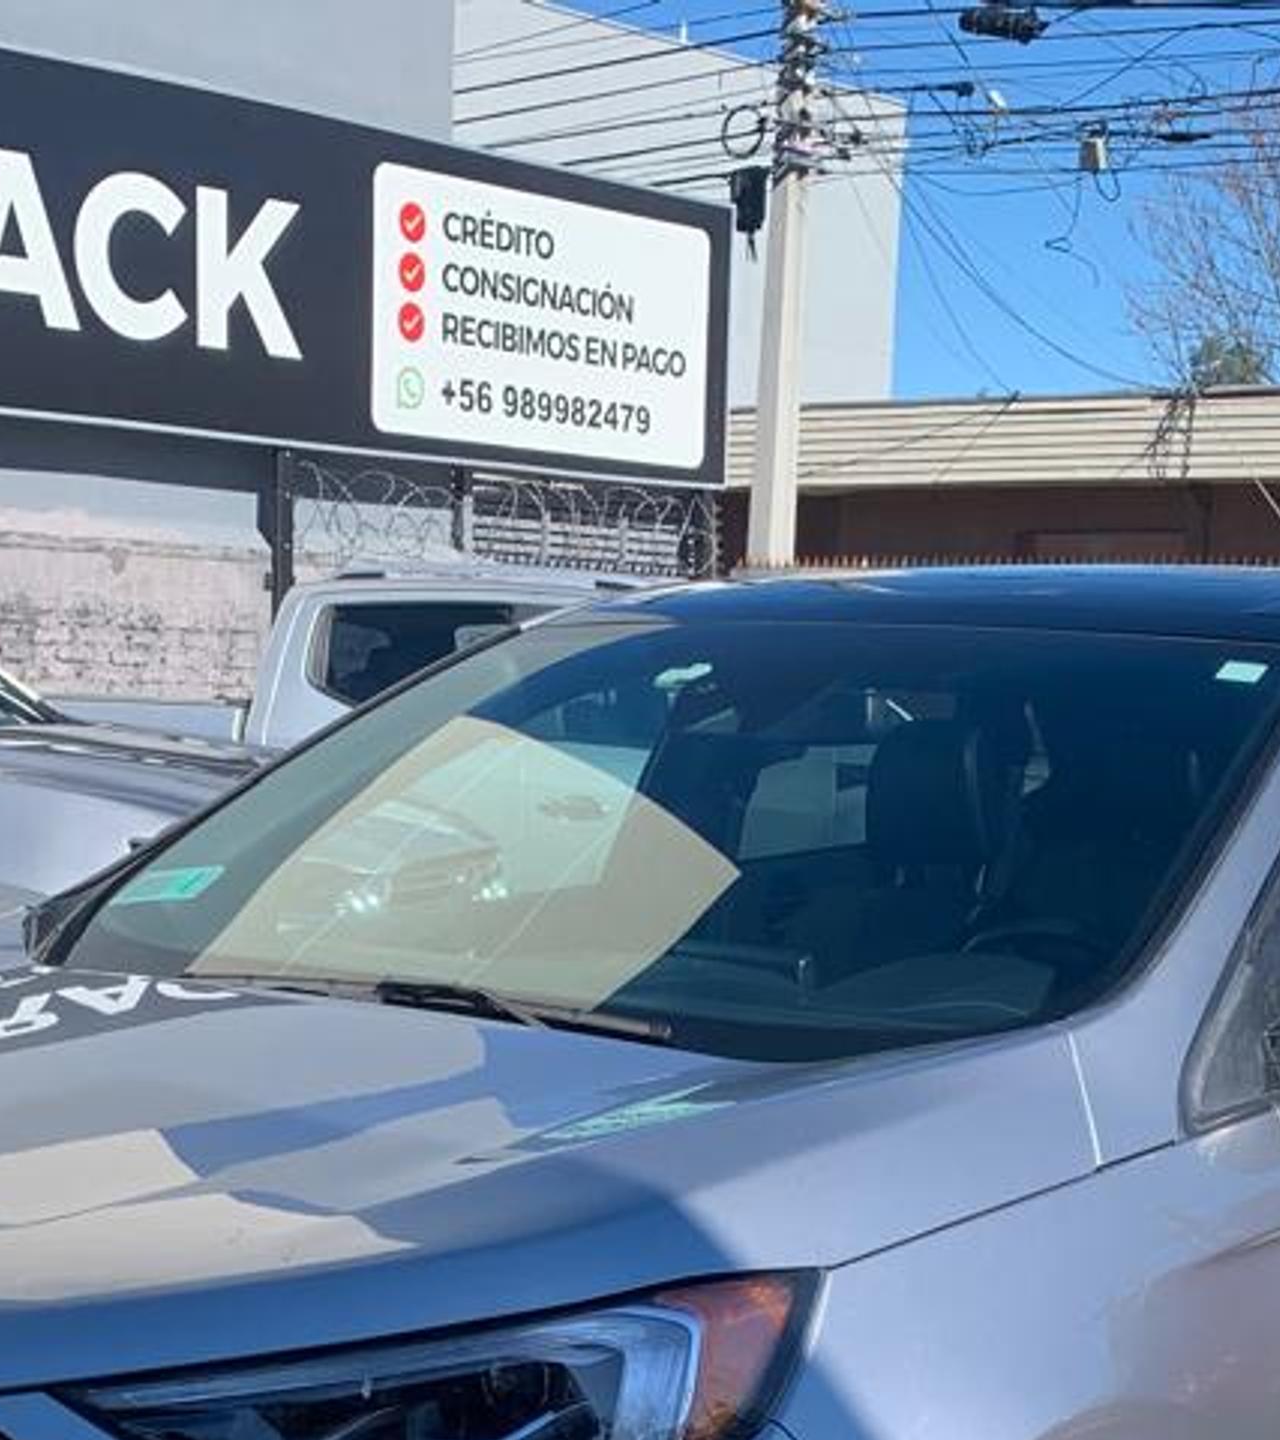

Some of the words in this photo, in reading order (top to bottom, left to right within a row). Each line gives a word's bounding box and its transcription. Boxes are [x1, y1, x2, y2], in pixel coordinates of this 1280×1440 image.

[442, 209, 555, 259] CRÉDITO
[442, 263, 634, 324] CONSIGNACIÓN
[441, 313, 581, 362] RECIBIMOS
[585, 337, 617, 368] EN
[622, 343, 687, 378] PAGO
[441, 378, 492, 413] +56
[503, 385, 651, 435] 989982479
